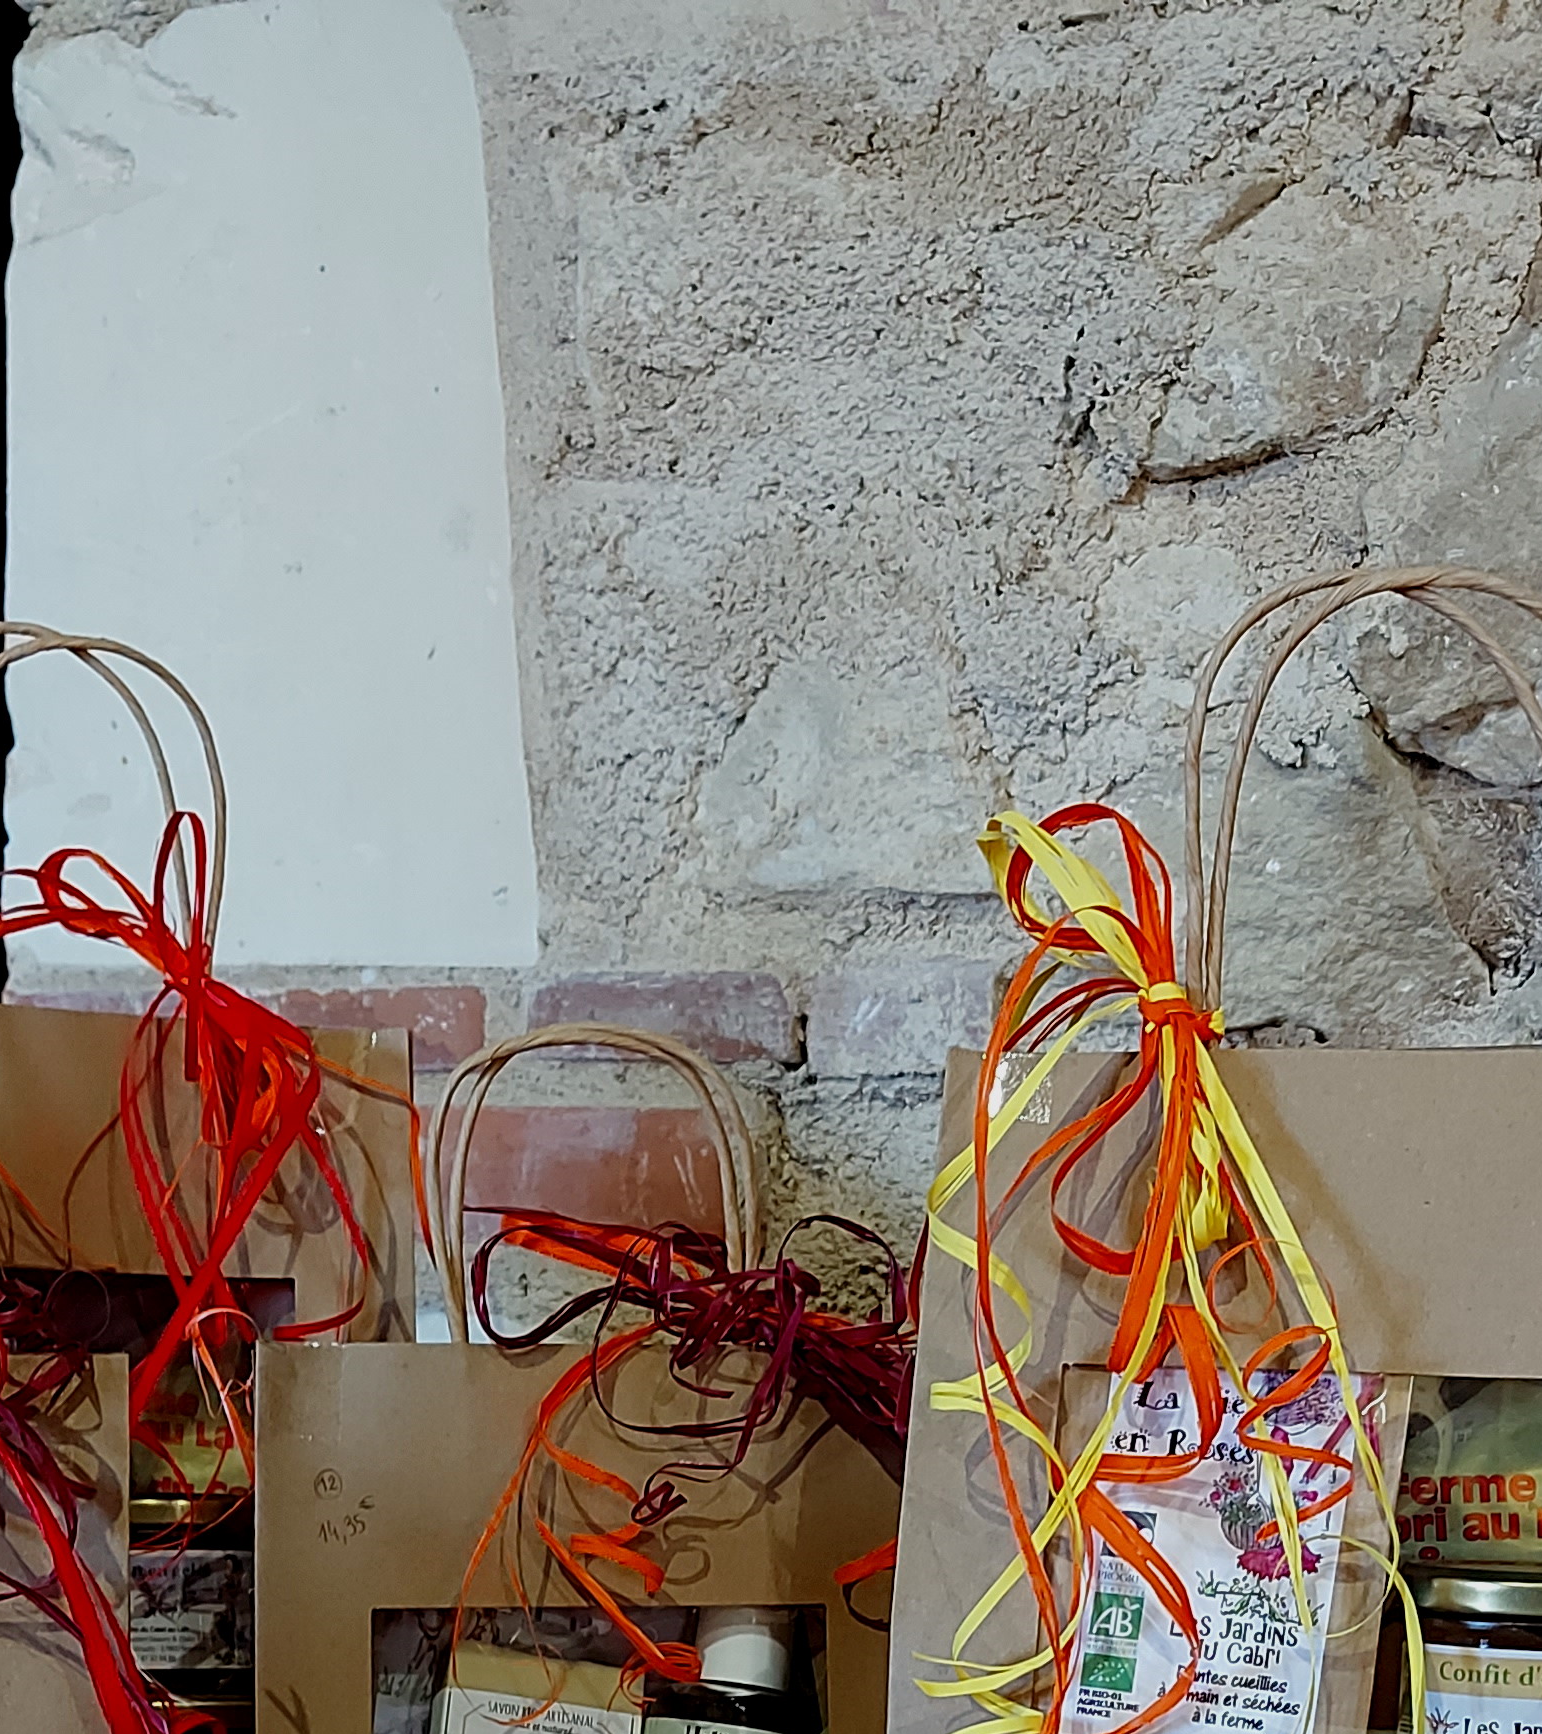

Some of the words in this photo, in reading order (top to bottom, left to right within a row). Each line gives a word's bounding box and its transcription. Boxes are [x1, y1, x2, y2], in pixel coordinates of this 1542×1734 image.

[1114, 1430, 1149, 1452] en
[1462, 1511, 1520, 1541] au
[1439, 1661, 1512, 1685] Confit
[1223, 1694, 1238, 1708] et
[1242, 1695, 1301, 1716] séchées
[1205, 1709, 1217, 1723] la
[1221, 1712, 1264, 1731] ferme
